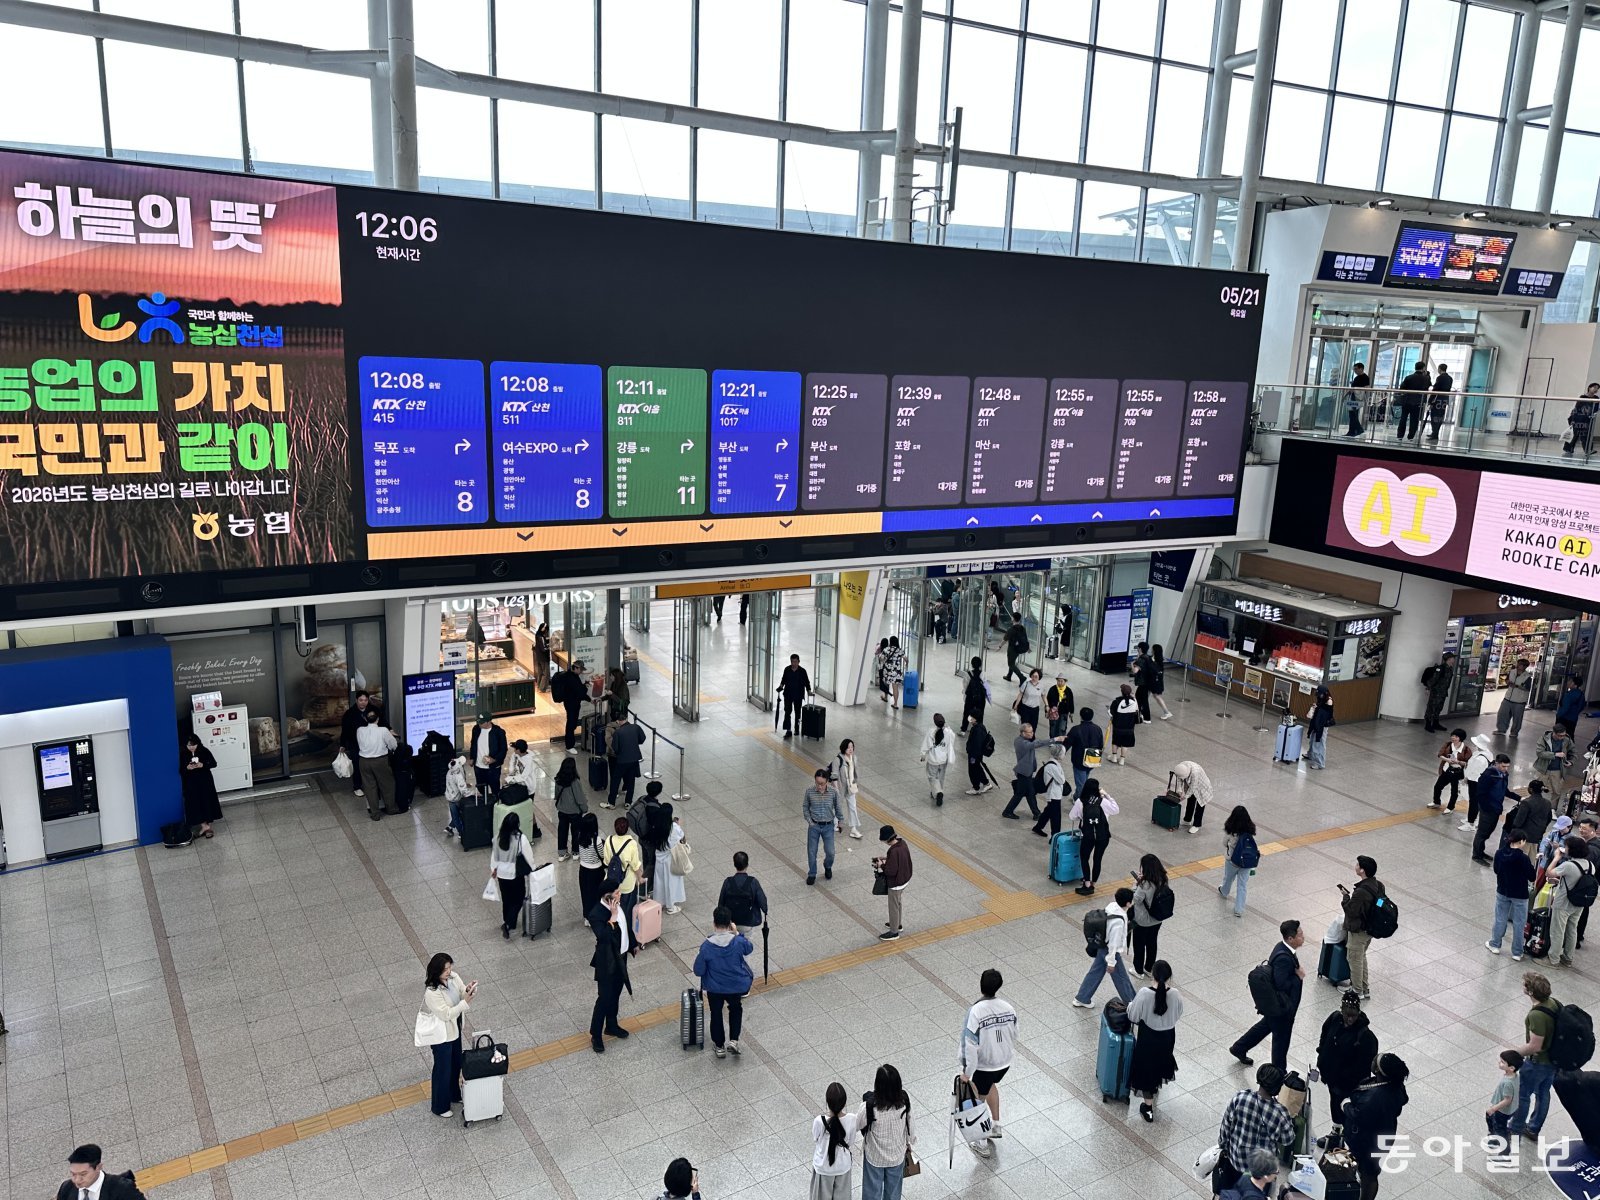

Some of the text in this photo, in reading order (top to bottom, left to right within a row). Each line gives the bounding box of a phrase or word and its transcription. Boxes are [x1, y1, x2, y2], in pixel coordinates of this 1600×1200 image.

[13, 181, 194, 249] 하늘의
[355, 211, 438, 243] 12:06
[376, 246, 421, 262] 현재시간
[1335, 270, 1346, 279] 타는
[1347, 271, 1353, 280] 곳
[1221, 287, 1259, 306] 05/21
[187, 309, 254, 323] 국민과 함께하는
[188, 322, 283, 348] 농심천심
[371, 372, 424, 389] 12:08
[501, 376, 548, 392] 12:08
[173, 362, 285, 412] 가치
[617, 380, 653, 394] 12:11
[720, 383, 754, 397] 12:21
[813, 385, 847, 398] 12:25
[898, 387, 931, 399] 12:39
[980, 388, 1011, 400] 12:48
[1056, 389, 1084, 401] 12:55
[1127, 390, 1154, 401] 12:55
[1194, 391, 1218, 402] 12:58
[373, 398, 426, 410] KTX 산천
[502, 401, 550, 412] KTX 산천
[617, 403, 646, 413] KTX
[812, 406, 836, 415] KTX
[897, 406, 920, 416] KTX
[978, 407, 1000, 416] KTX
[1054, 407, 1075, 416] KTX
[1125, 408, 1143, 416] KTX
[1191, 408, 1209, 416] KTX
[374, 413, 394, 423] 415
[503, 415, 519, 424] 511
[618, 417, 632, 425] 811
[720, 418, 738, 426] 1017
[812, 418, 827, 426] 029
[178, 422, 289, 472] 같이
[374, 442, 399, 454] 목포
[503, 442, 558, 454] 여수EXPO
[617, 442, 637, 453] 강릉
[719, 442, 737, 453] 부산
[811, 441, 827, 452] 부산
[895, 440, 911, 450] 포항
[976, 440, 990, 450] 마산
[1051, 439, 1065, 449] 강릉
[1121, 438, 1134, 447] 부전
[1187, 438, 1200, 446] 포항
[938, 482, 957, 490] 대기중
[1015, 480, 1033, 488] 대기중
[1087, 478, 1104, 486] 대기중
[1155, 476, 1171, 484] 대기중
[12, 479, 291, 503] 2026년도 농심천심의 길로 나아갑니다
[776, 484, 786, 501] 7
[857, 484, 877, 493] 대기중
[576, 489, 589, 508] 8
[678, 487, 695, 504] 11
[458, 492, 473, 512] 8
[1359, 479, 1439, 545] AI
[1510, 501, 1590, 521] 대한민국 곳곳에서 찾은
[1518, 514, 1533, 524] 지역
[1534, 516, 1549, 526] 인재
[1551, 519, 1567, 529] 양성
[1568, 521, 1600, 533] 프로젝트
[1505, 529, 1587, 555] KAKAO AI
[1502, 548, 1564, 572] ROOKIE
[843, 581, 856, 594] 나오는
[1235, 599, 1283, 622] 에그타르트
[176, 662, 202, 672] Freshly
[229, 657, 248, 668] Every
[249, 656, 263, 665] Day
